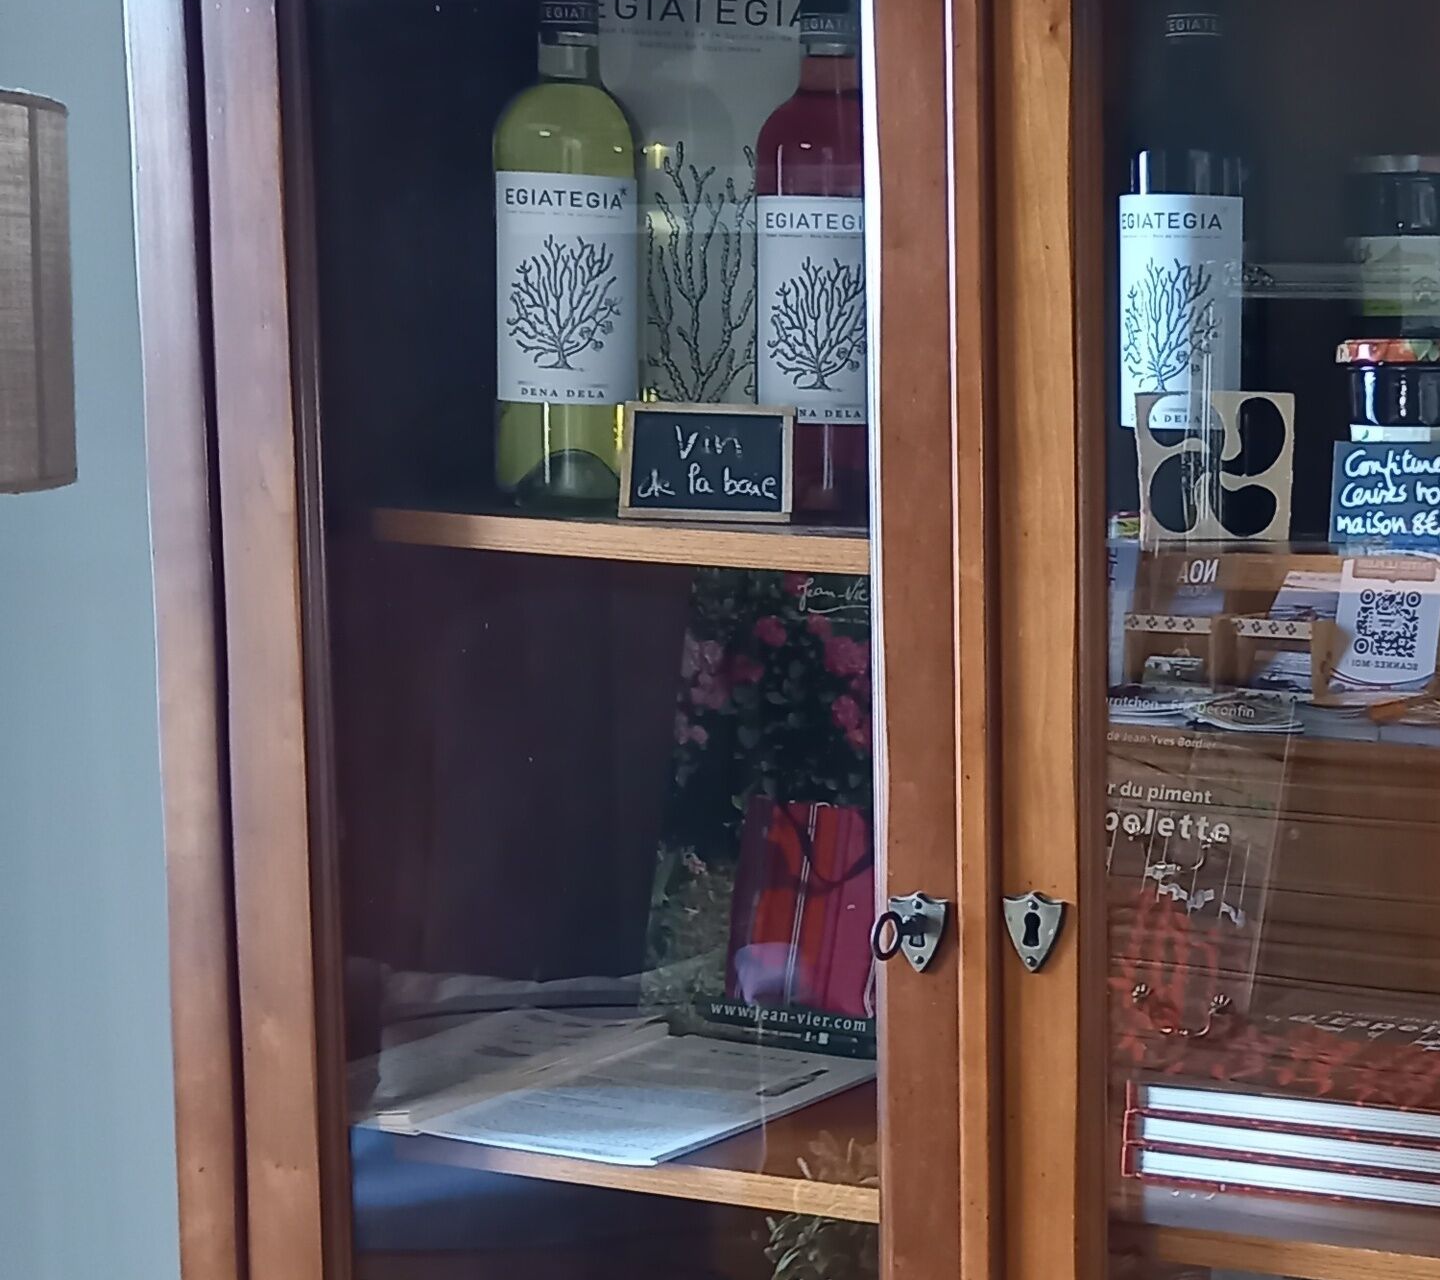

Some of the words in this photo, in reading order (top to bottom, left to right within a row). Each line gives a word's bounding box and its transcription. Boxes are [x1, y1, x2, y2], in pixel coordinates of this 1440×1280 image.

[505, 187, 623, 210] EGIATEGIA
[1122, 212, 1223, 231] EGIATEGIA
[521, 387, 558, 398] DENA
[566, 388, 606, 399] DELA
[824, 409, 862, 419] DELA
[675, 424, 743, 460] Vin
[637, 468, 676, 498] de
[689, 461, 711, 494] la
[724, 467, 778, 500] baie
[1336, 510, 1407, 536] maison
[1120, 781, 1143, 798] du
[1147, 785, 1213, 803] piment
